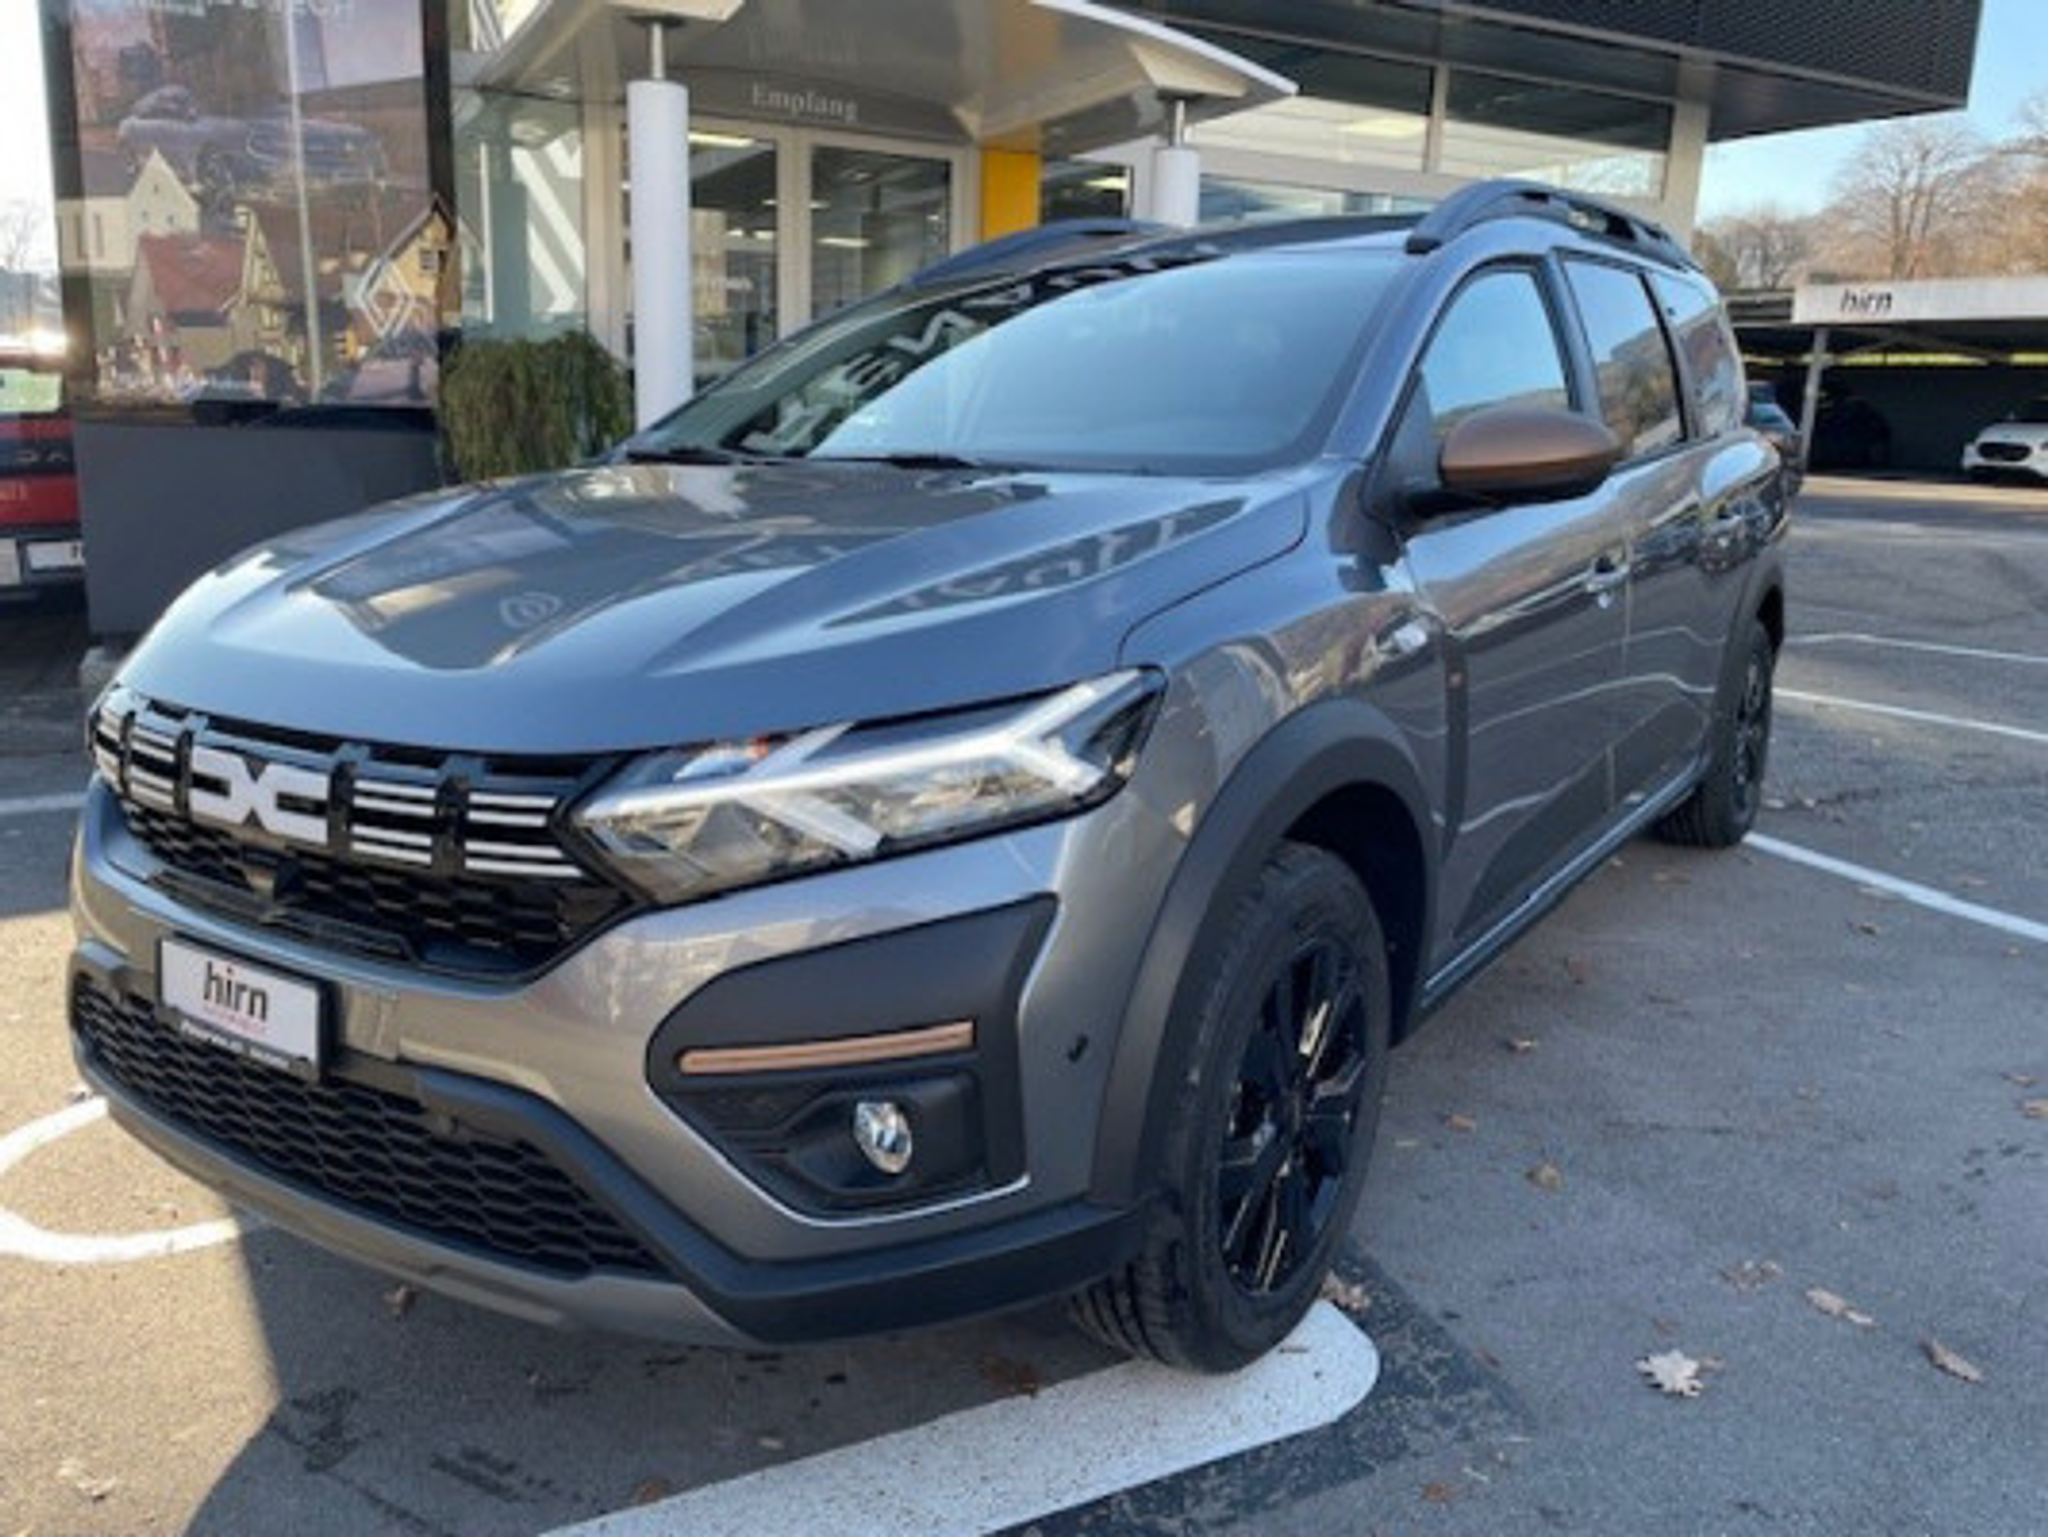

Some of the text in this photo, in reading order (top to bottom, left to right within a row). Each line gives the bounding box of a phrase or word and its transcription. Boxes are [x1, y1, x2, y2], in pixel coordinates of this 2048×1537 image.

[752, 80, 858, 124] Empfang
[1840, 286, 1893, 314] hirn
[203, 960, 268, 1021] hirn
